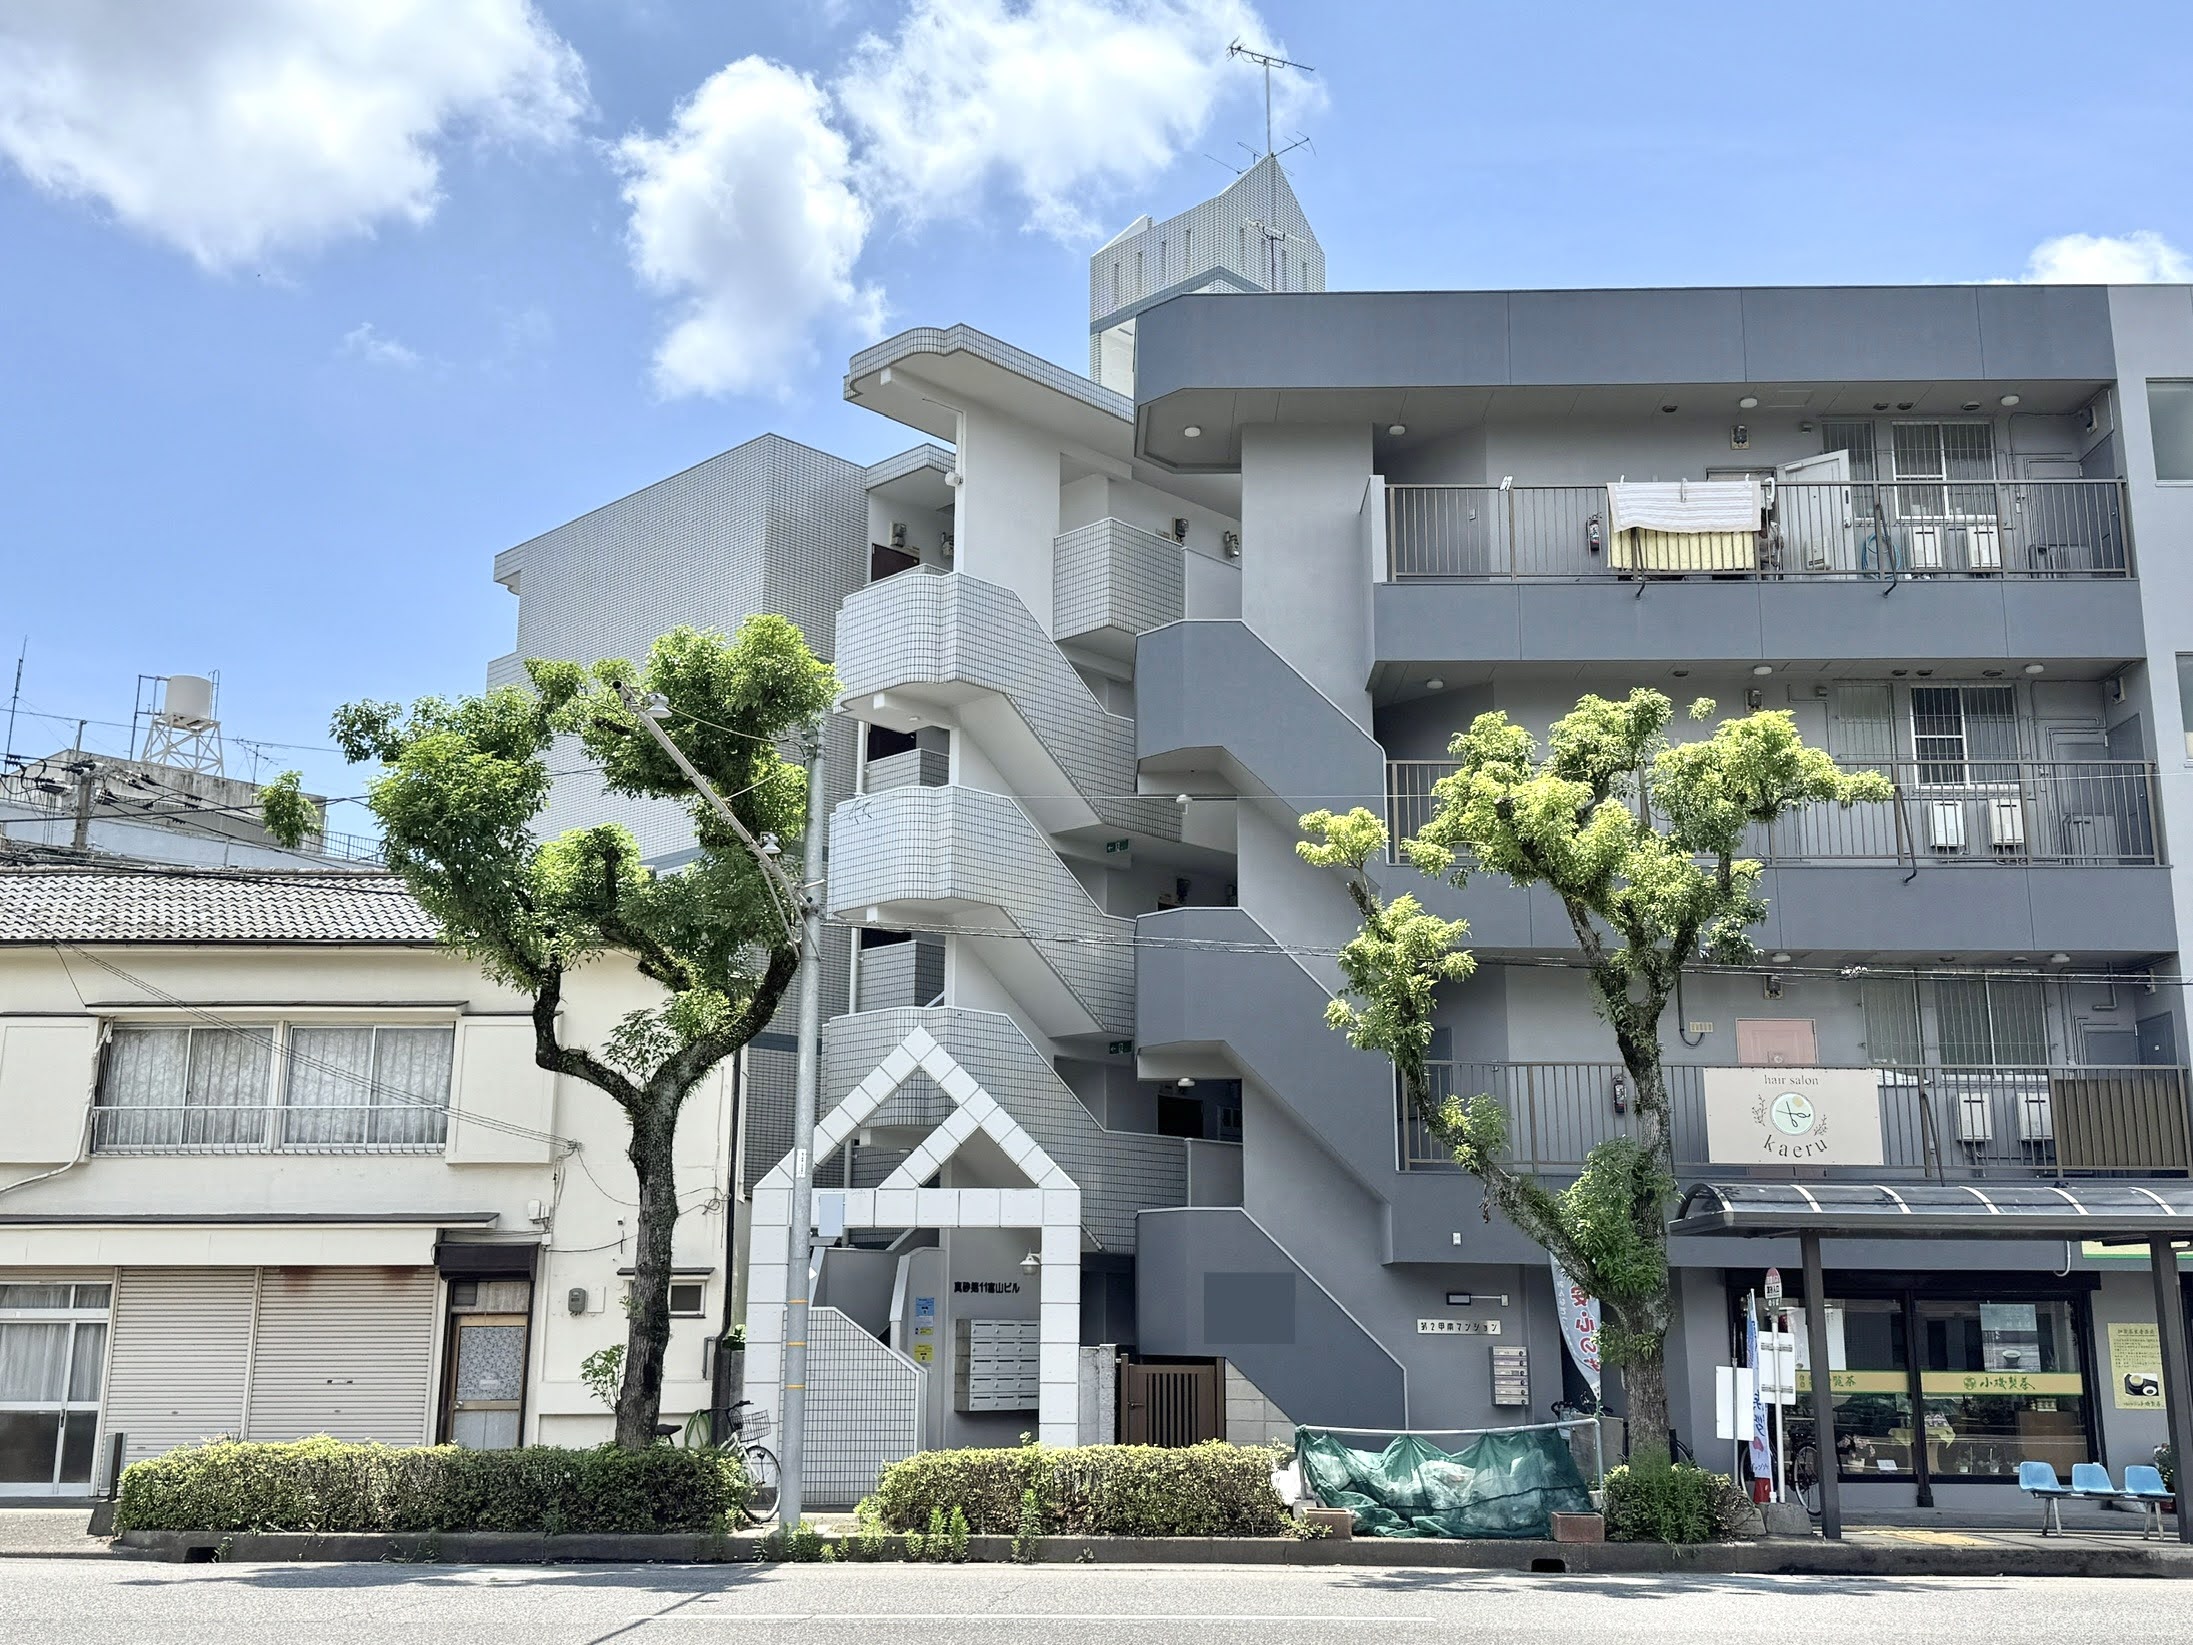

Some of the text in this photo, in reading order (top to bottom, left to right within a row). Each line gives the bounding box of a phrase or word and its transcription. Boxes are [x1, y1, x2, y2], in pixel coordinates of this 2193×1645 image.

[1764, 1074, 1819, 1085] hair salon
[1763, 1134, 1828, 1158] kaeru
